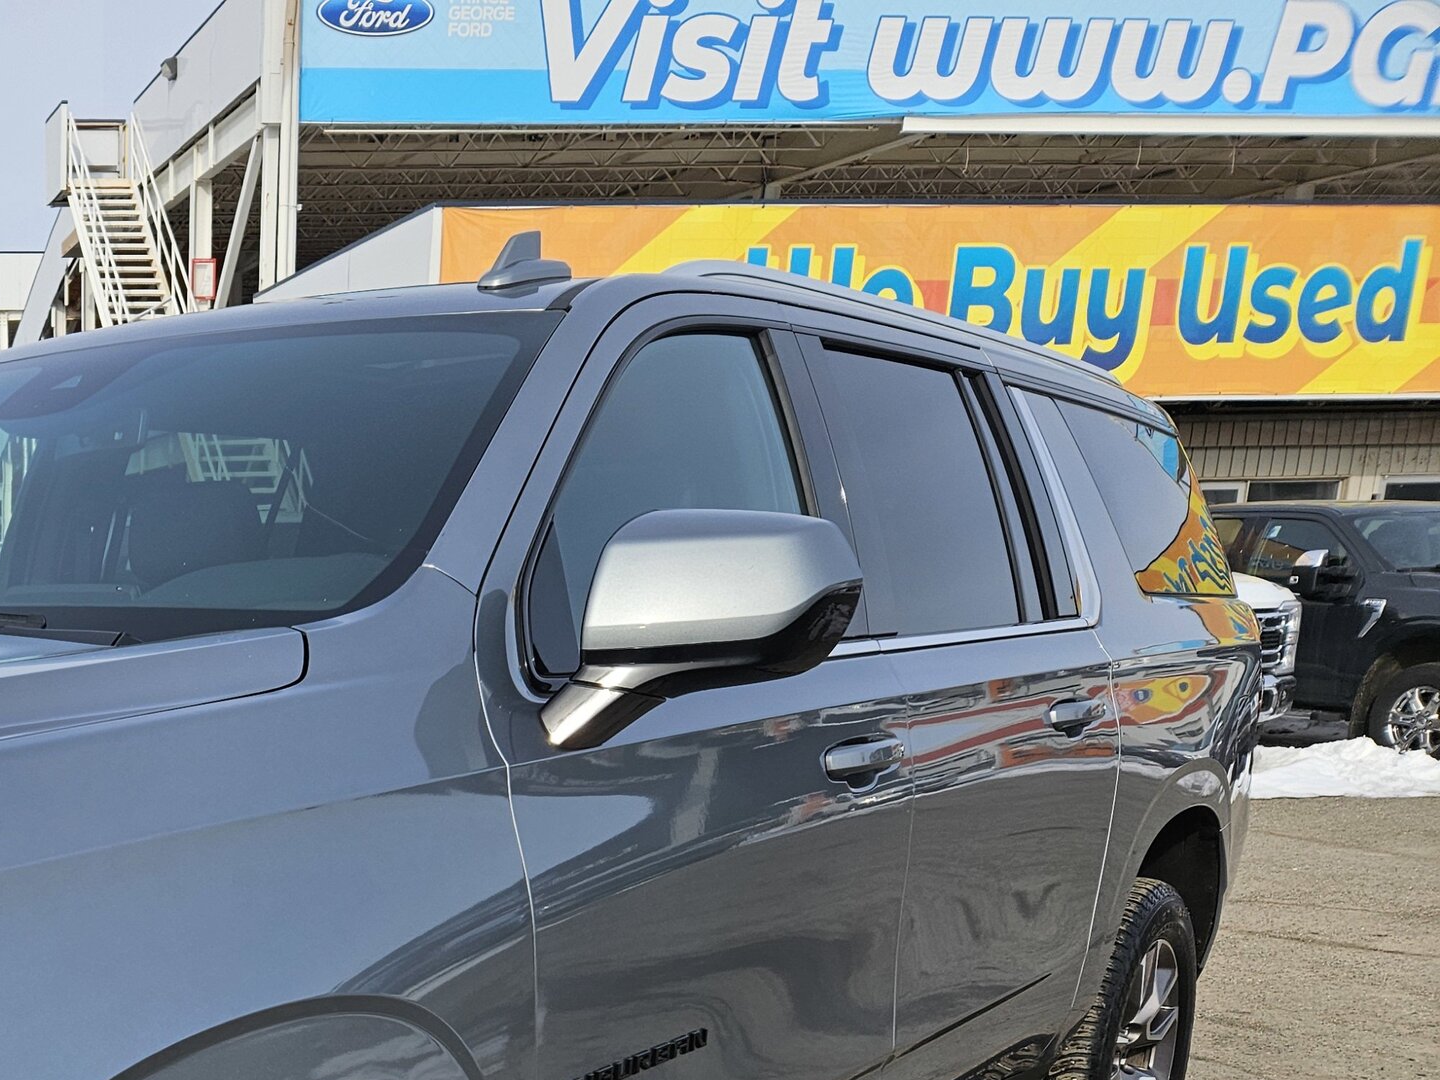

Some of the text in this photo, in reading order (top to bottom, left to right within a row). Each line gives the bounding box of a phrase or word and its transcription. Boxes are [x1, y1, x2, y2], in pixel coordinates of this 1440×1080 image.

[339, 0, 412, 29] Ford
[447, 5, 515, 21] GEORGE
[447, 22, 493, 38] FORD
[540, 0, 1440, 107] Visit www.PG
[949, 243, 1148, 372] Buy
[1176, 238, 1426, 346] Used
